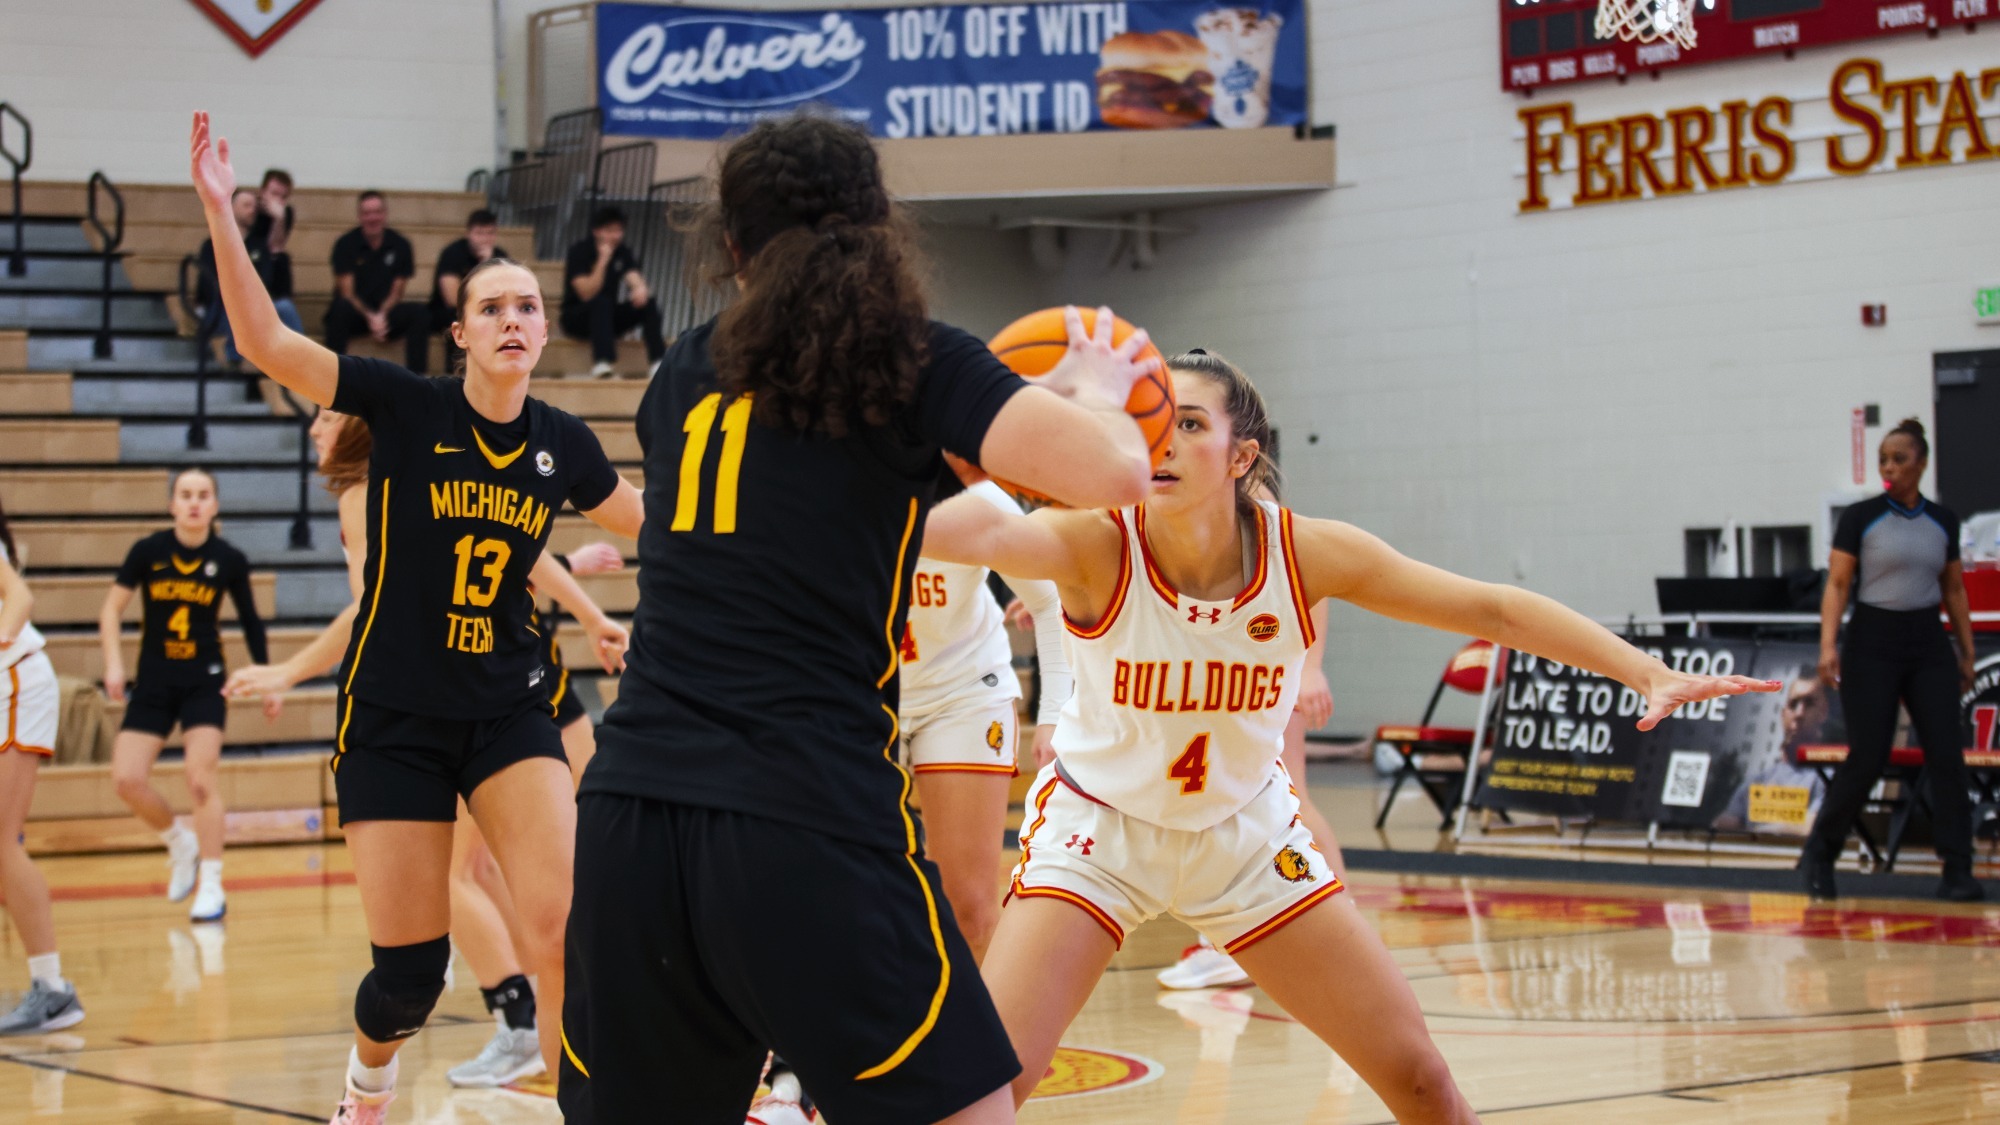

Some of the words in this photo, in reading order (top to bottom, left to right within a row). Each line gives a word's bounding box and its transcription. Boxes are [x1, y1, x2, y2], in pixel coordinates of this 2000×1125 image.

[604, 12, 866, 103] Culver's
[883, 8, 956, 61] 10%
[964, 6, 1029, 58] OFF
[1036, 2, 1128, 56] WITH
[884, 82, 1046, 138] STUDENT
[1053, 80, 1090, 133] ID
[1517, 96, 1797, 213] FERRIS
[670, 391, 755, 534] 11
[430, 481, 549, 540] MICHIGAN
[454, 534, 511, 607] 13
[167, 604, 190, 640] 4
[446, 612, 493, 654] TECH
[1250, 625, 1277, 634] GLIAC
[1113, 659, 1284, 713] BULLDOGS
[1671, 648, 1735, 678] TOO
[1506, 680, 1570, 714] LATE
[1576, 683, 1613, 716] TO
[1167, 732, 1211, 795] 4
[1504, 717, 1536, 748] TO
[1540, 719, 1614, 754] LEAD.
